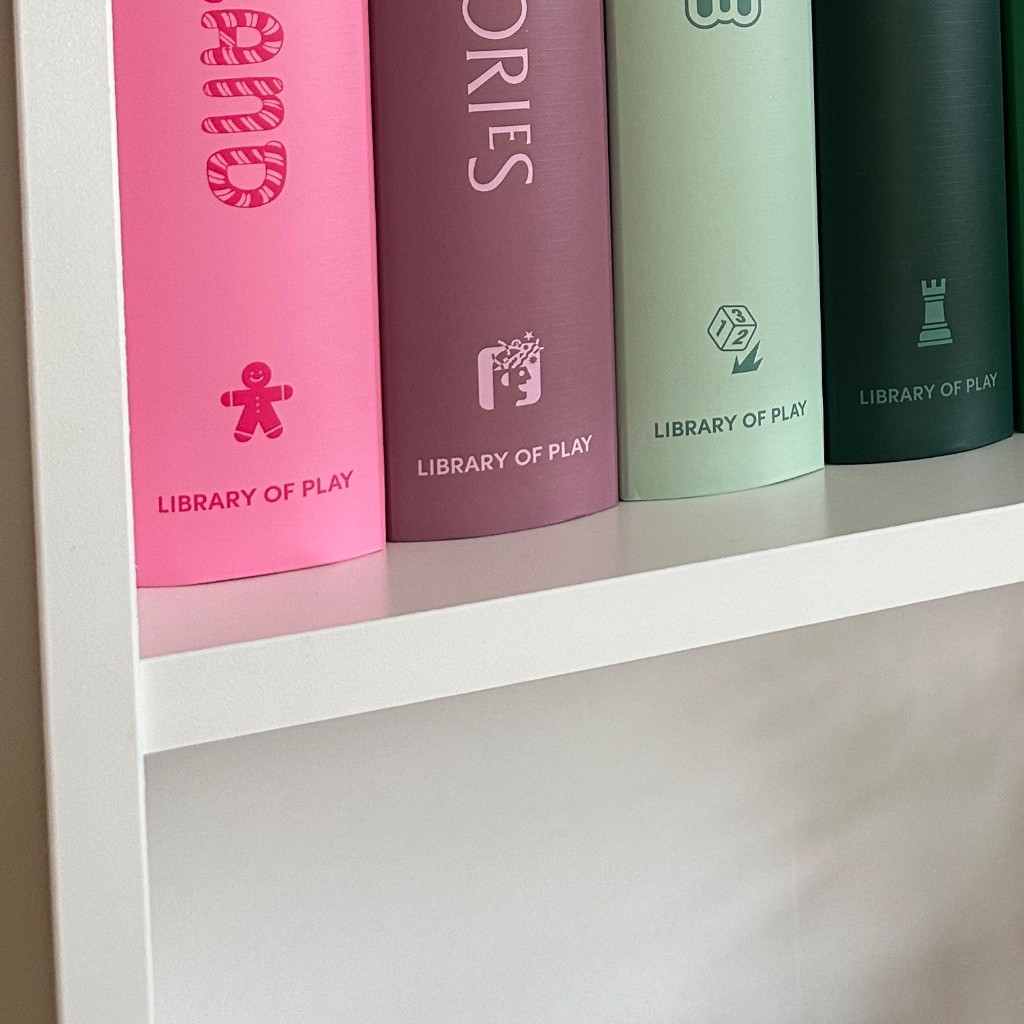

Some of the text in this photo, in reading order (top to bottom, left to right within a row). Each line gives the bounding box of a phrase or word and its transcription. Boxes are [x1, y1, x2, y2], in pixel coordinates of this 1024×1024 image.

[859, 372, 998, 405] LIBRARY OF PLAY
[654, 400, 808, 439] LIBRARY OF PLAY
[417, 435, 594, 476] LIBRARY OF PLAY
[158, 470, 355, 514] LIBRARY OF PLAY
